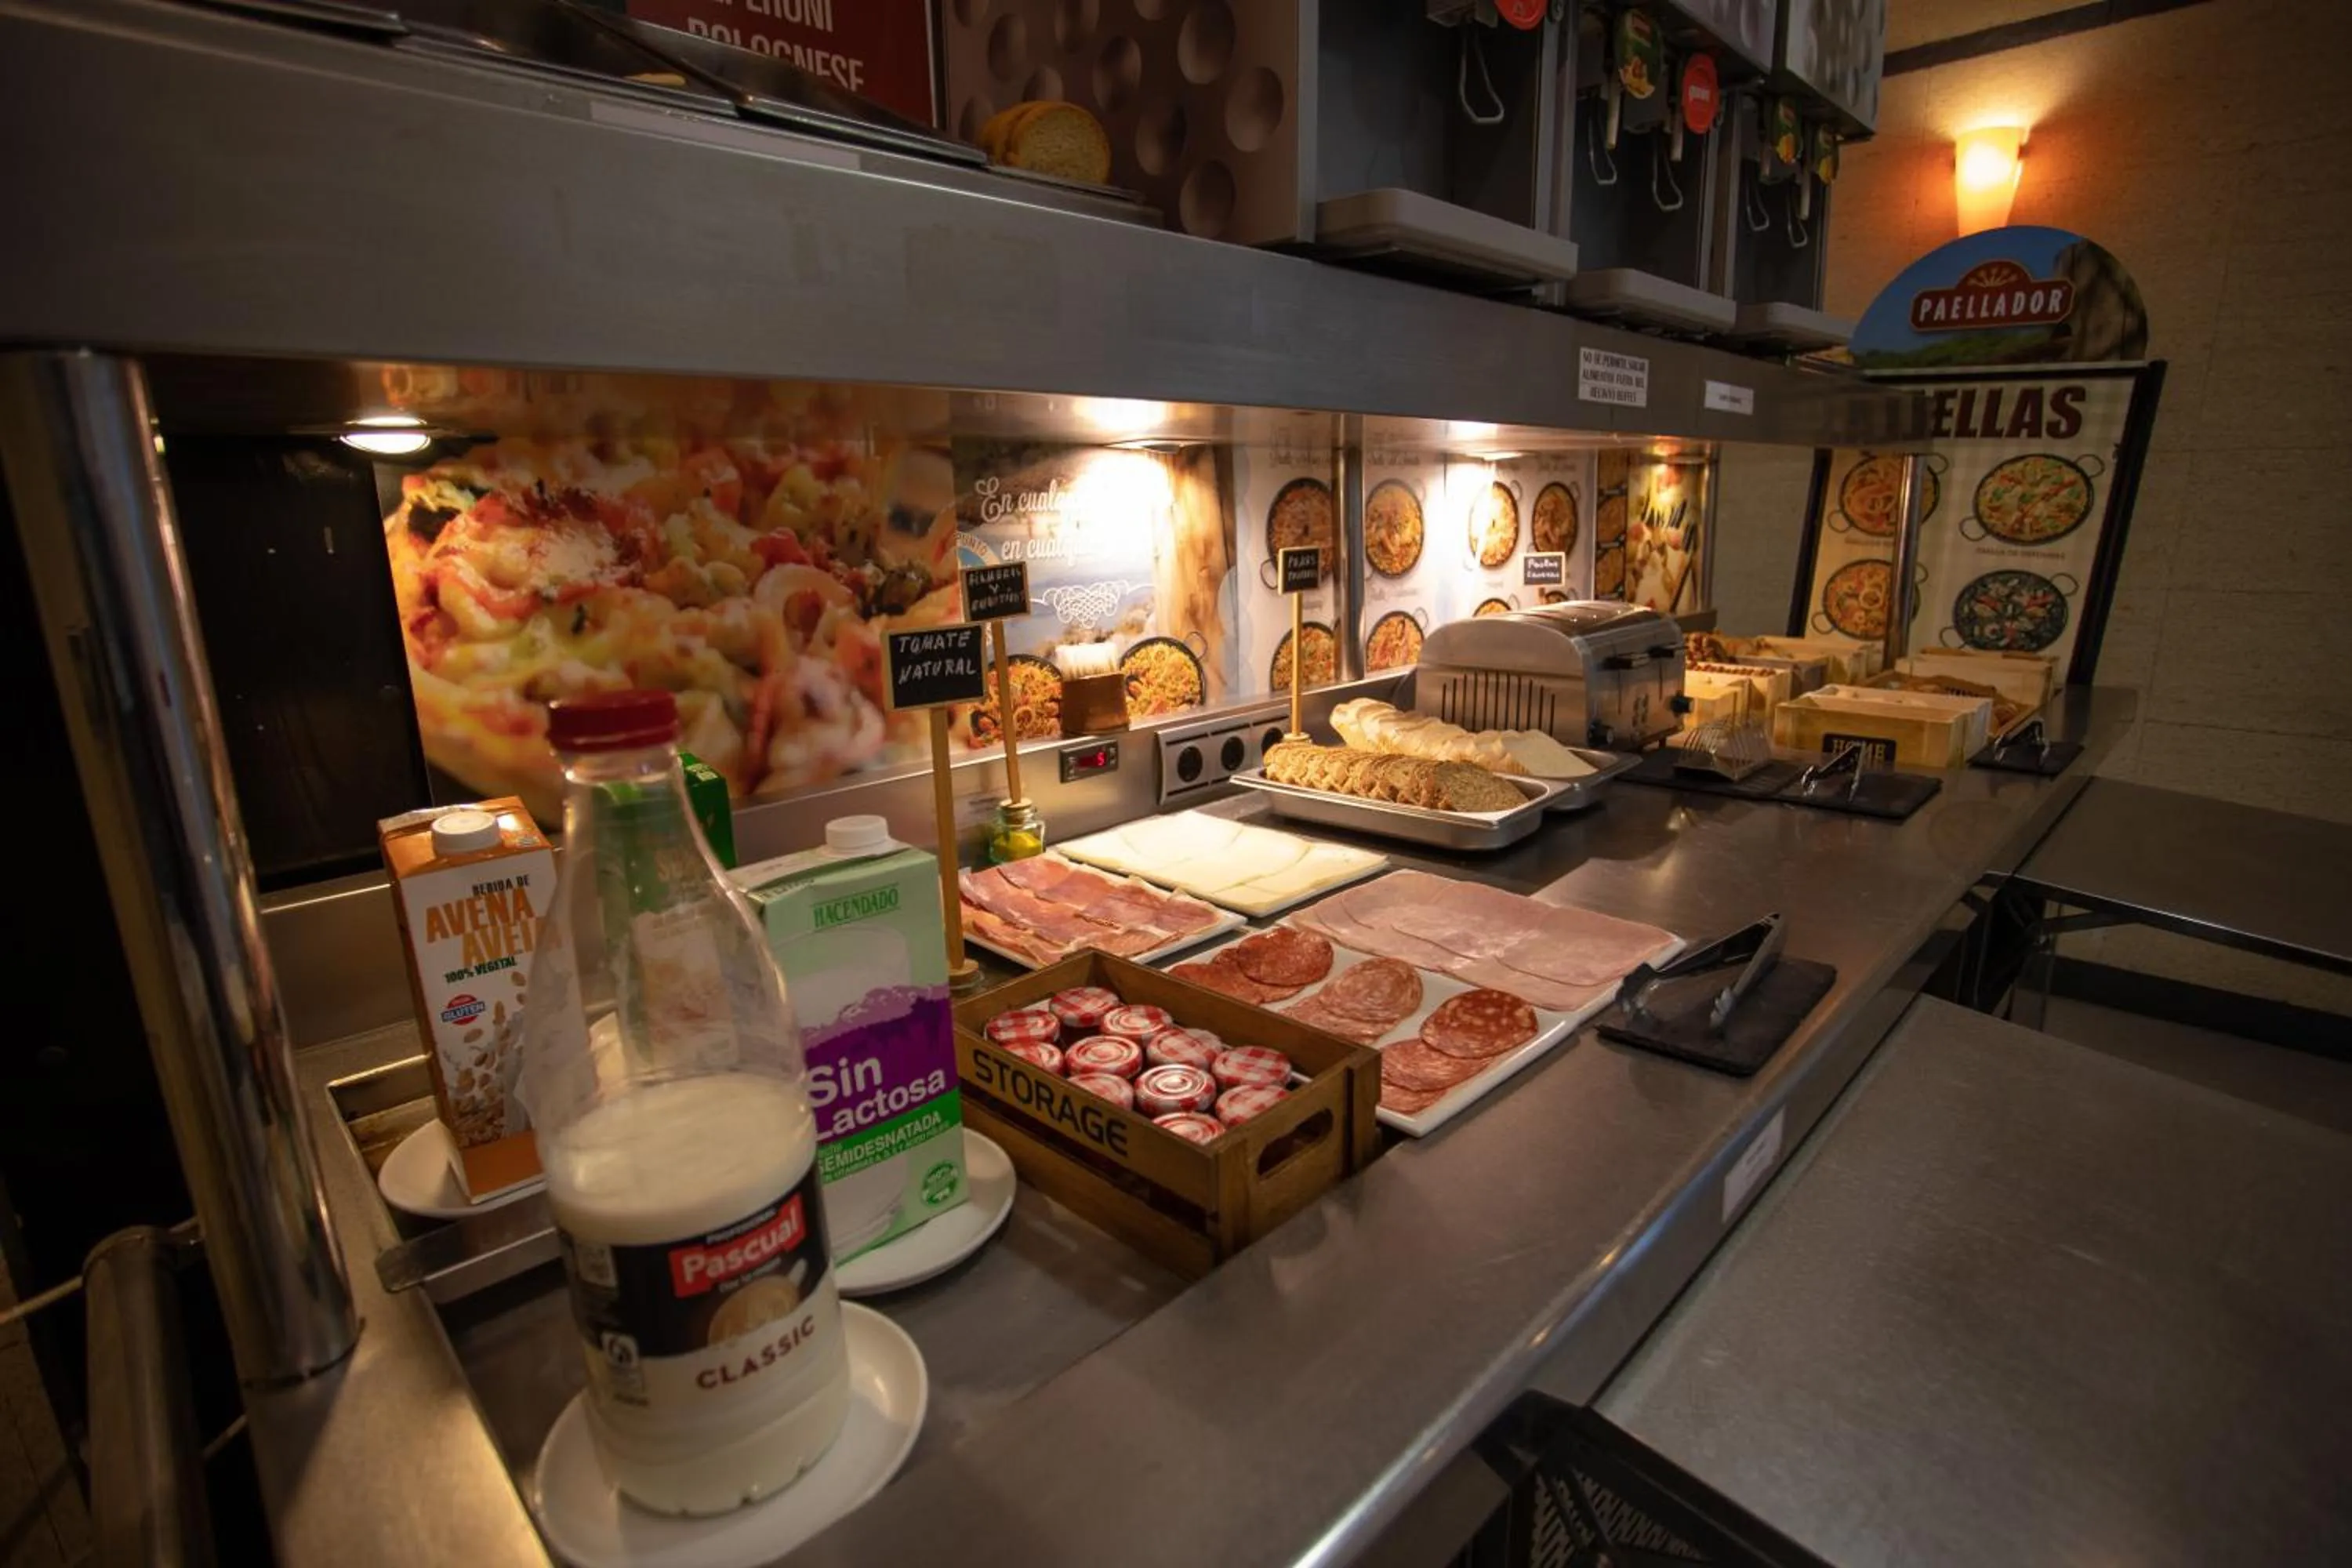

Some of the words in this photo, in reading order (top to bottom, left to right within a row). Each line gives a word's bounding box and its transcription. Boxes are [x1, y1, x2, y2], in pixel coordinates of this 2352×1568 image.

[1918, 289, 2063, 322] PAELLADOR
[1932, 386, 2085, 439] ELLAS
[975, 476, 1013, 523] En
[1001, 538, 1022, 561] en
[898, 630, 971, 655] TOMATE
[898, 657, 977, 685] NATURAL
[472, 877, 514, 897] BEBIDA
[515, 873, 530, 887] DE
[426, 887, 535, 944] AVENA
[813, 887, 899, 929] HACENDADO
[445, 967, 474, 984] 100%
[474, 956, 517, 976] VEGETAL
[807, 1055, 883, 1109] Sin
[972, 1048, 1128, 1157] STORAGE
[681, 1205, 799, 1286] Pascual
[695, 1315, 815, 1392] CLASSIC
